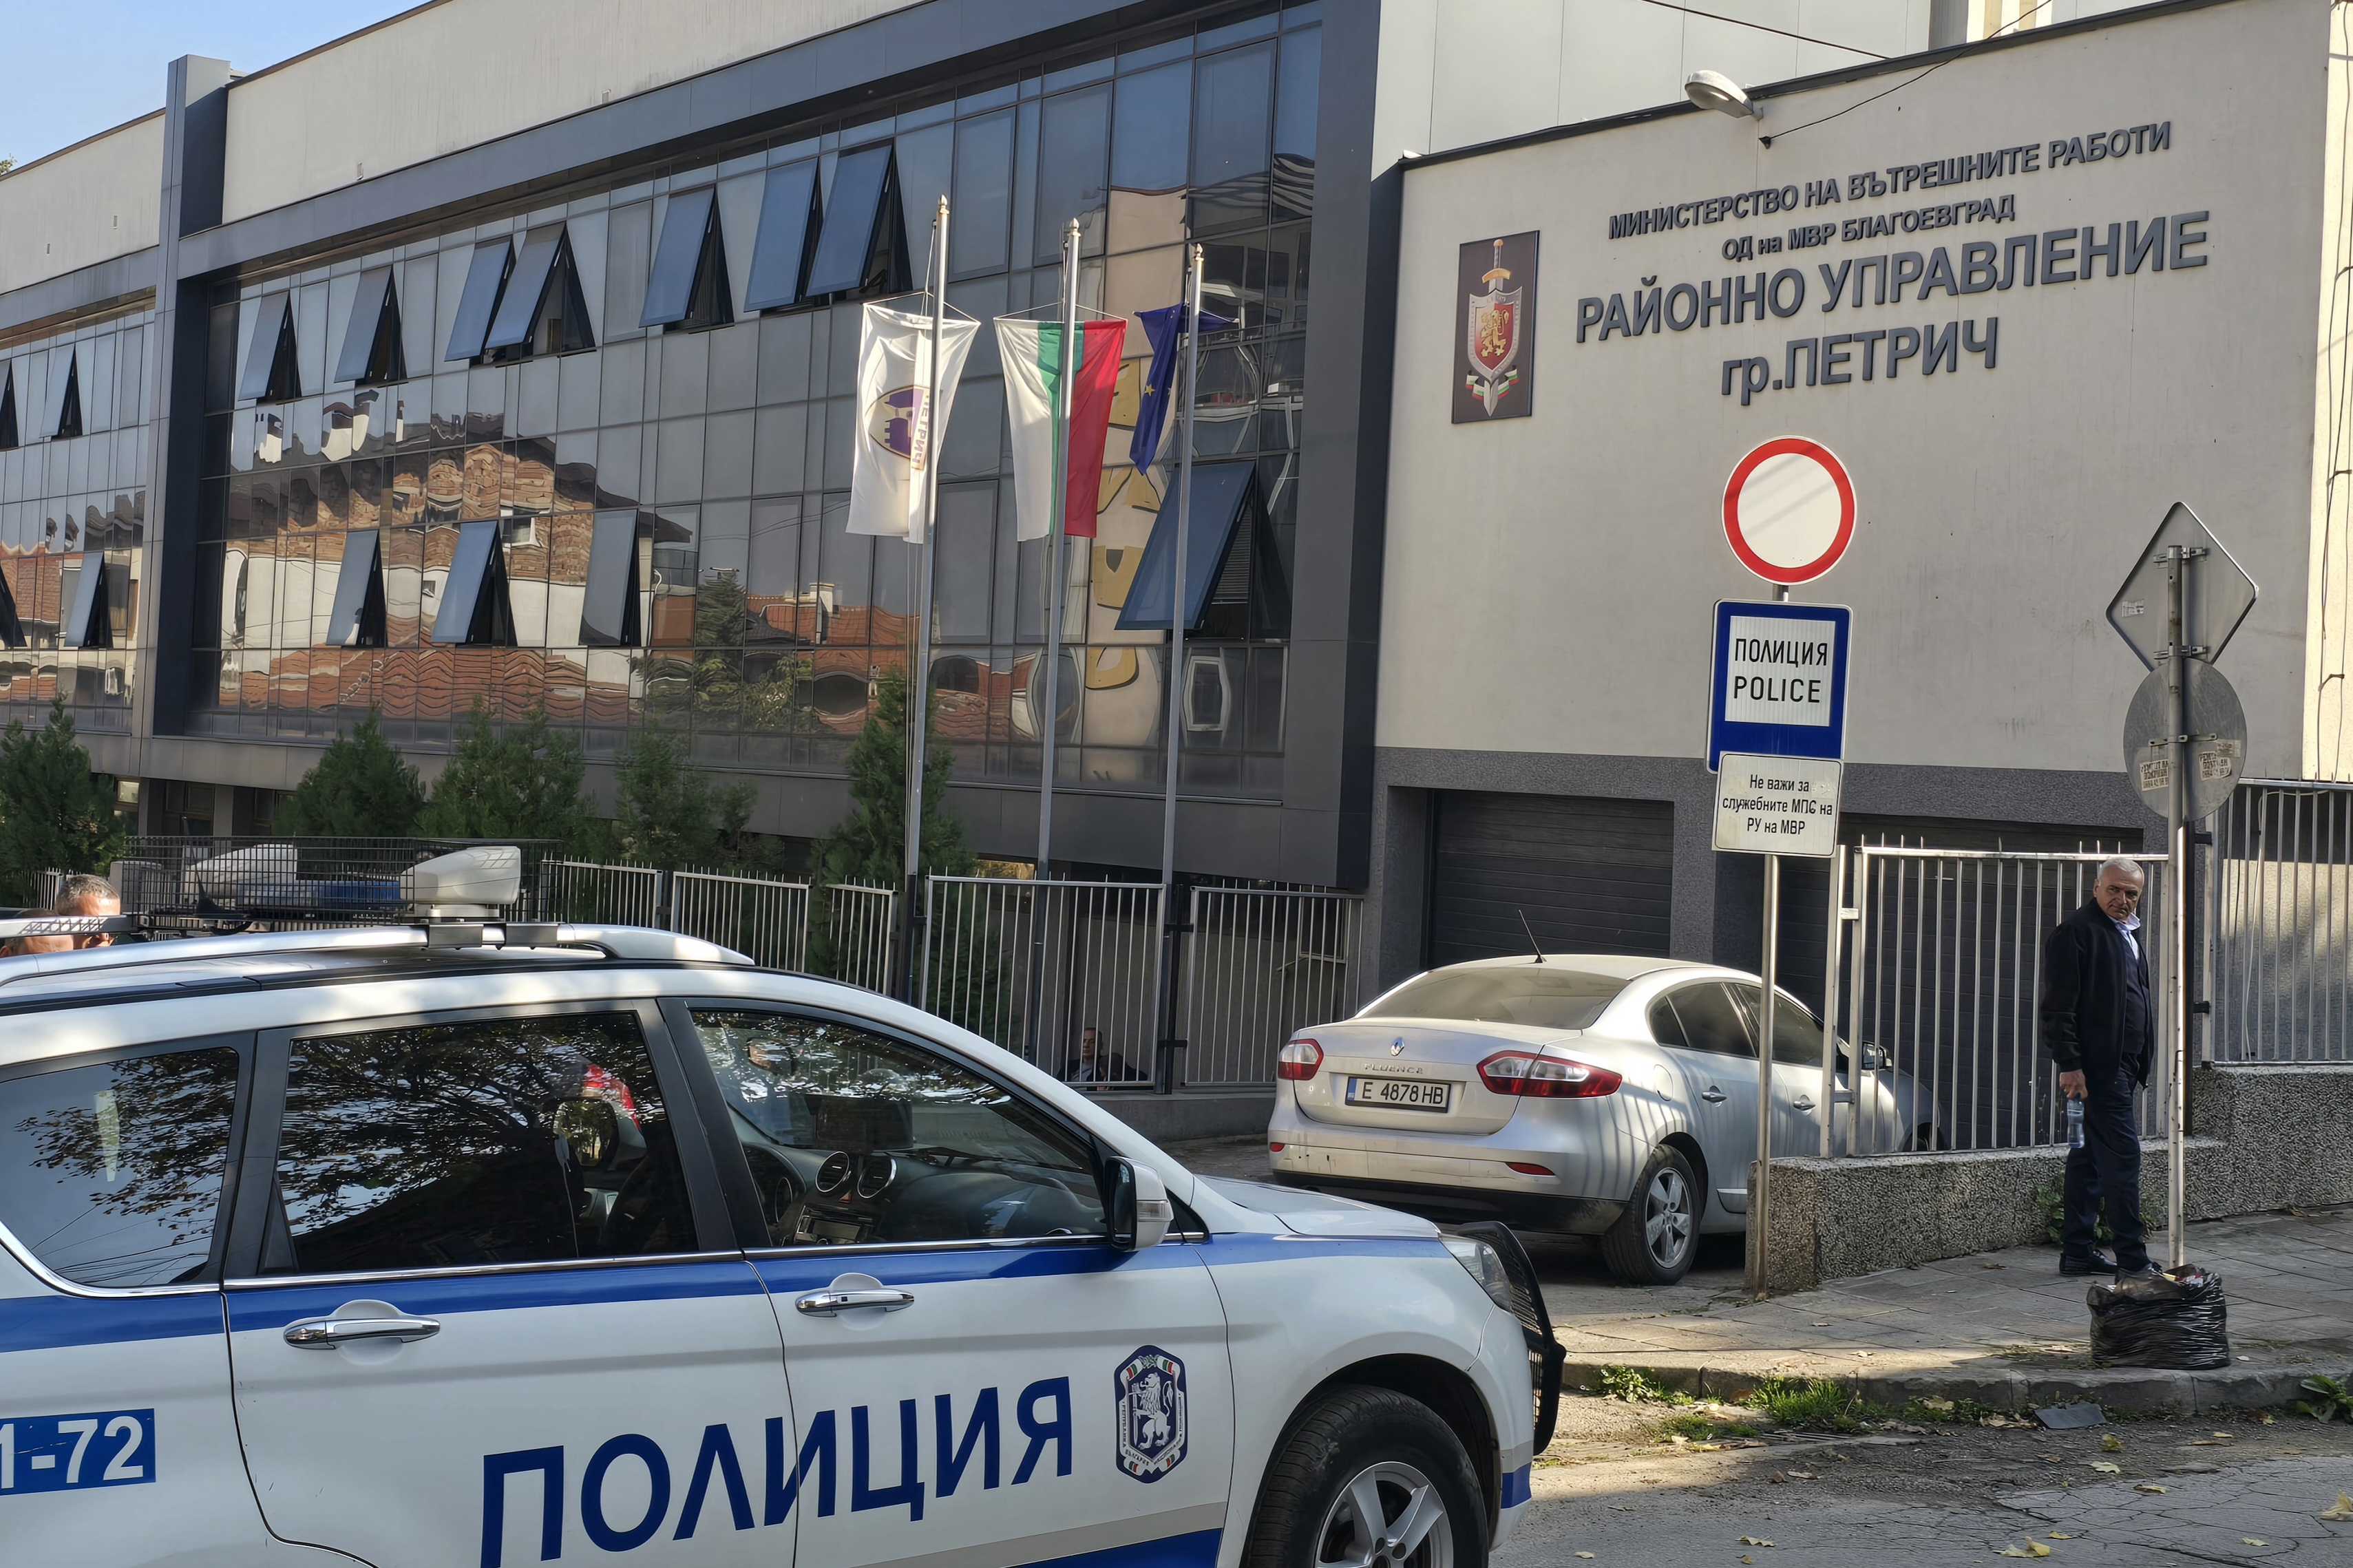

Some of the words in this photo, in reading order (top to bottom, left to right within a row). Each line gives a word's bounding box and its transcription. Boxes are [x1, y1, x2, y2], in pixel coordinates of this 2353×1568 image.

[1609, 184, 1799, 239] МИНИСТЕРСТВО
[1804, 178, 1841, 207] НА
[1848, 143, 2040, 201] ВЪТРЕШНИТЕ
[2047, 120, 2171, 169] РАБОТИ
[1721, 234, 1753, 262] ОД
[1758, 236, 1782, 255] на
[1787, 222, 1836, 251] МВР
[1842, 194, 2016, 243] БЛАГОЕВГРАД
[1576, 267, 1805, 343] РАЙОННО
[1818, 210, 2210, 313] УПРАВЛЕНИЕ
[1721, 316, 1998, 406] гр.ПЕТРИЧ
[1734, 638, 1828, 668] ПОЛИЦИЯ
[1733, 675, 1822, 703] POLICE
[1749, 774, 1764, 790] Не
[1767, 778, 1795, 792] важи
[1797, 781, 1809, 792] за
[1722, 796, 1788, 815] служебните
[1791, 798, 1817, 814] МПС
[1819, 803, 1833, 816] на
[1747, 817, 1762, 832] РУ
[1764, 823, 1777, 834] на
[1780, 819, 1806, 835] МВР
[1364, 1063, 1424, 1074] FLUENCE
[1380, 1083, 1419, 1102] 4878
[481, 1375, 1073, 1568] ПОЛИЦИЯ
